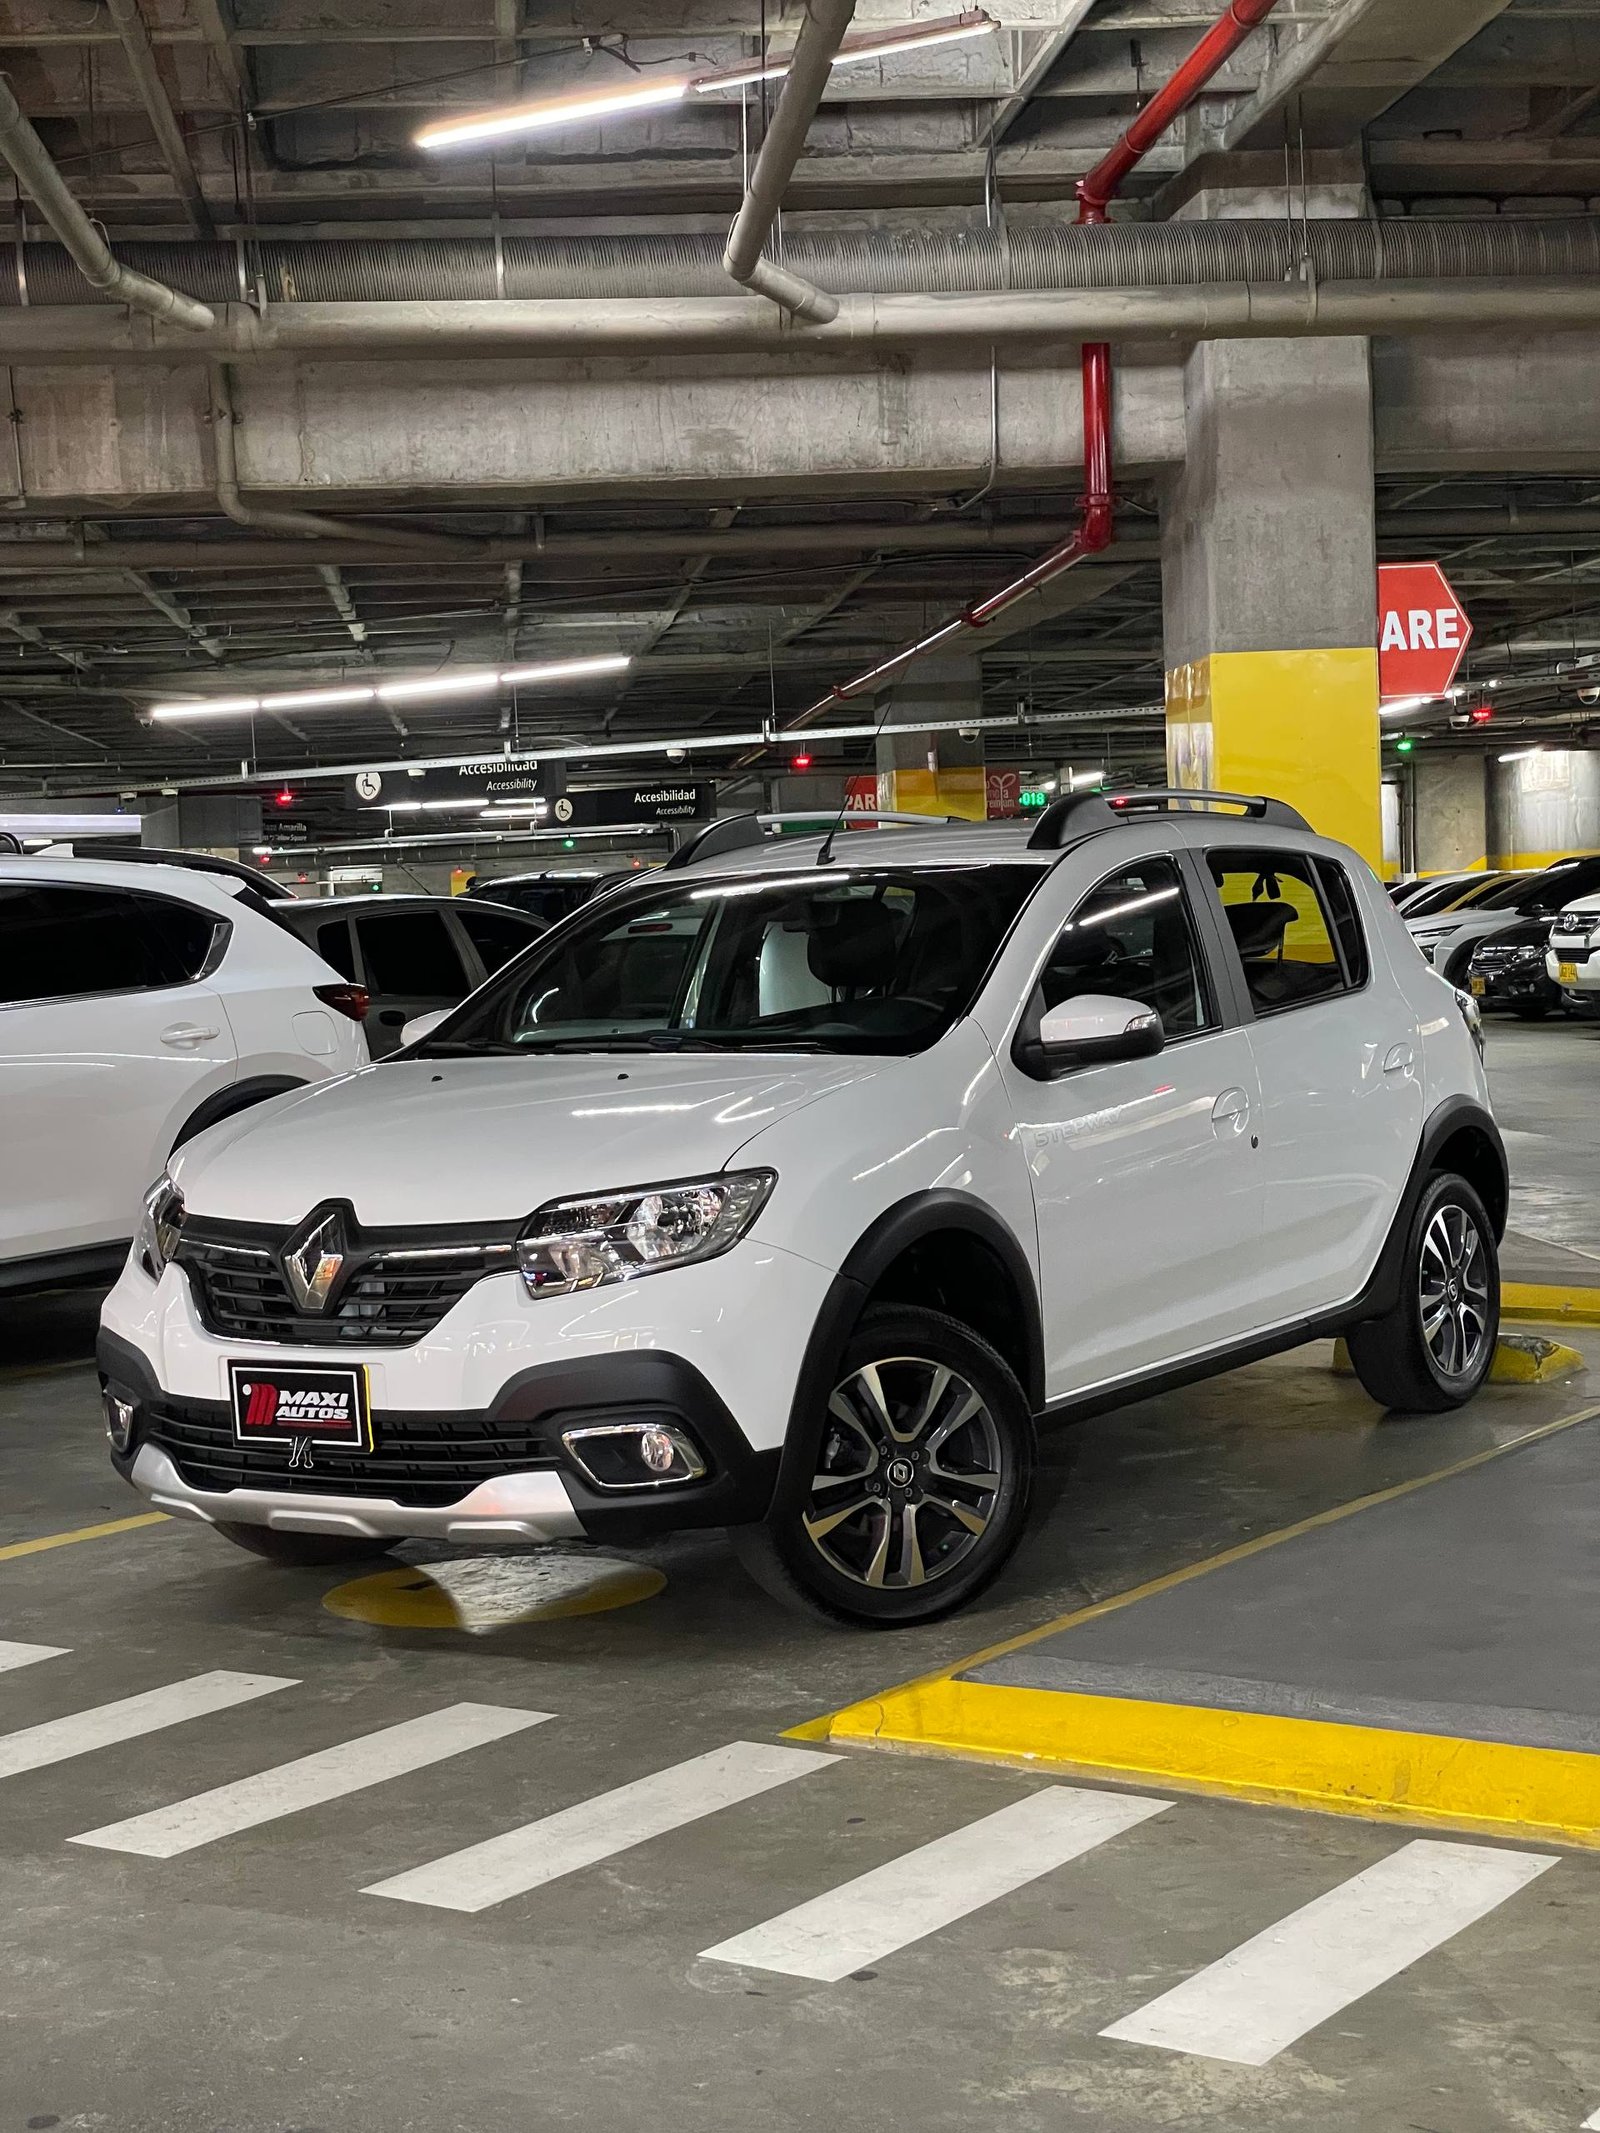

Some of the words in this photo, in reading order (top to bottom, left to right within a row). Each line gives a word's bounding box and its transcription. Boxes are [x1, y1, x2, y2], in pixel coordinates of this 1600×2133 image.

[1379, 608, 1460, 651] ARE
[486, 777, 538, 792] Accessibility
[634, 788, 696, 803] Accesibilidad
[844, 793, 876, 811] PAR
[1022, 792, 1045, 806] 018
[655, 805, 696, 815] Accessibility
[1034, 1105, 1123, 1147] STEPWAY
[278, 1390, 349, 1407] MAXI
[275, 1406, 349, 1420] AUTOS
